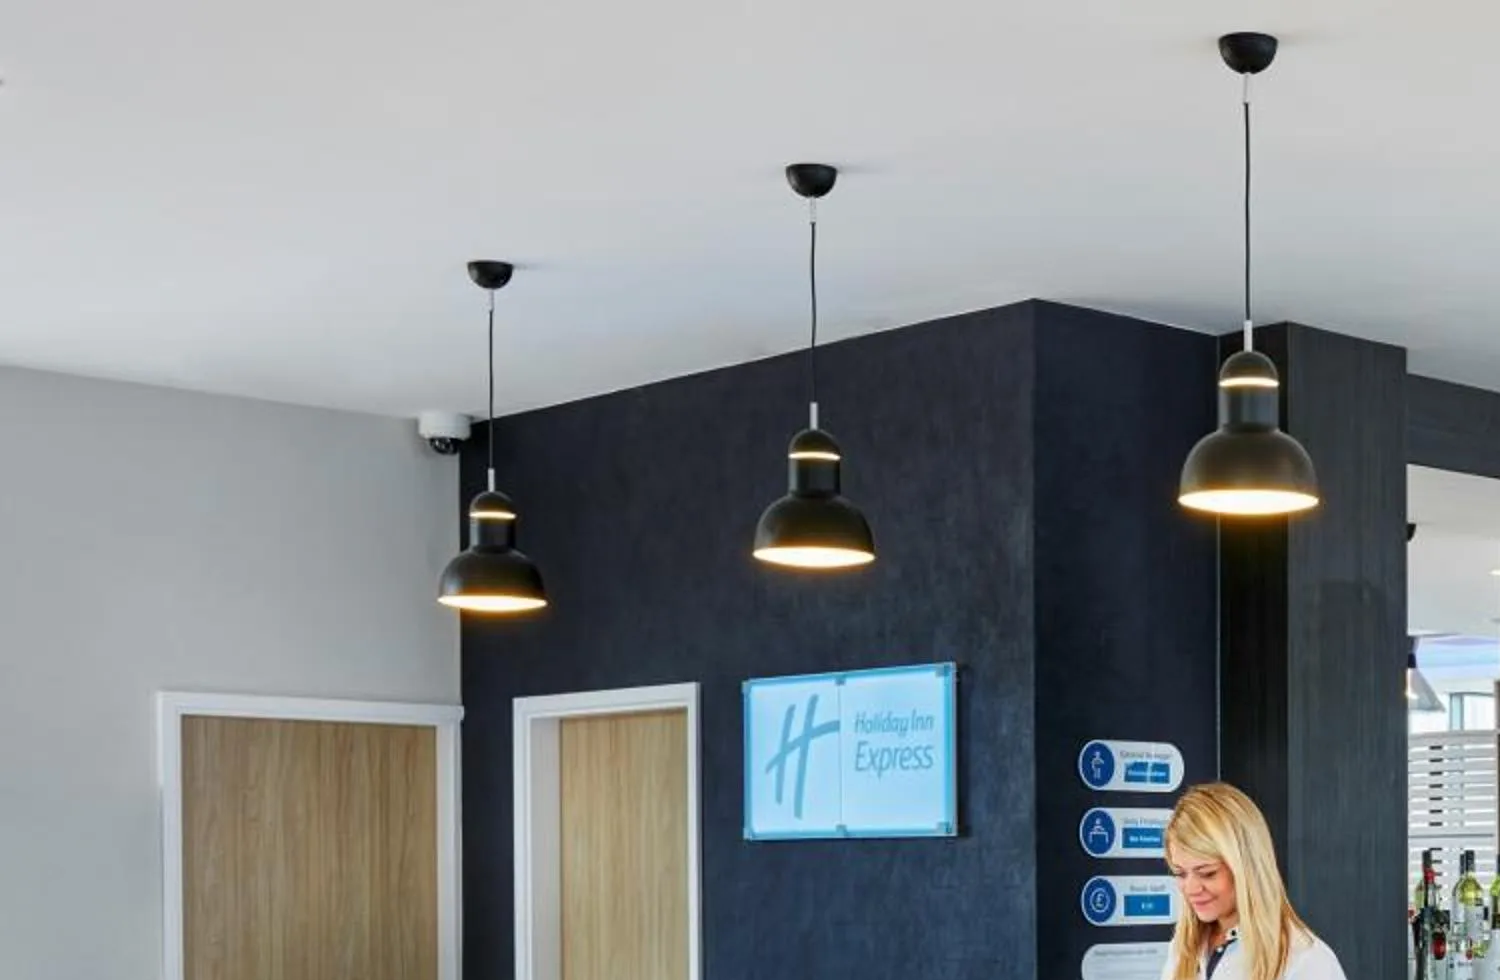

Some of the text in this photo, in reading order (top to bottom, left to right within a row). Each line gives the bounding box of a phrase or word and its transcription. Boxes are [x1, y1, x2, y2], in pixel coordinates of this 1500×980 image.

[854, 706, 935, 737] Holiday Inn
[854, 740, 935, 780] Express
